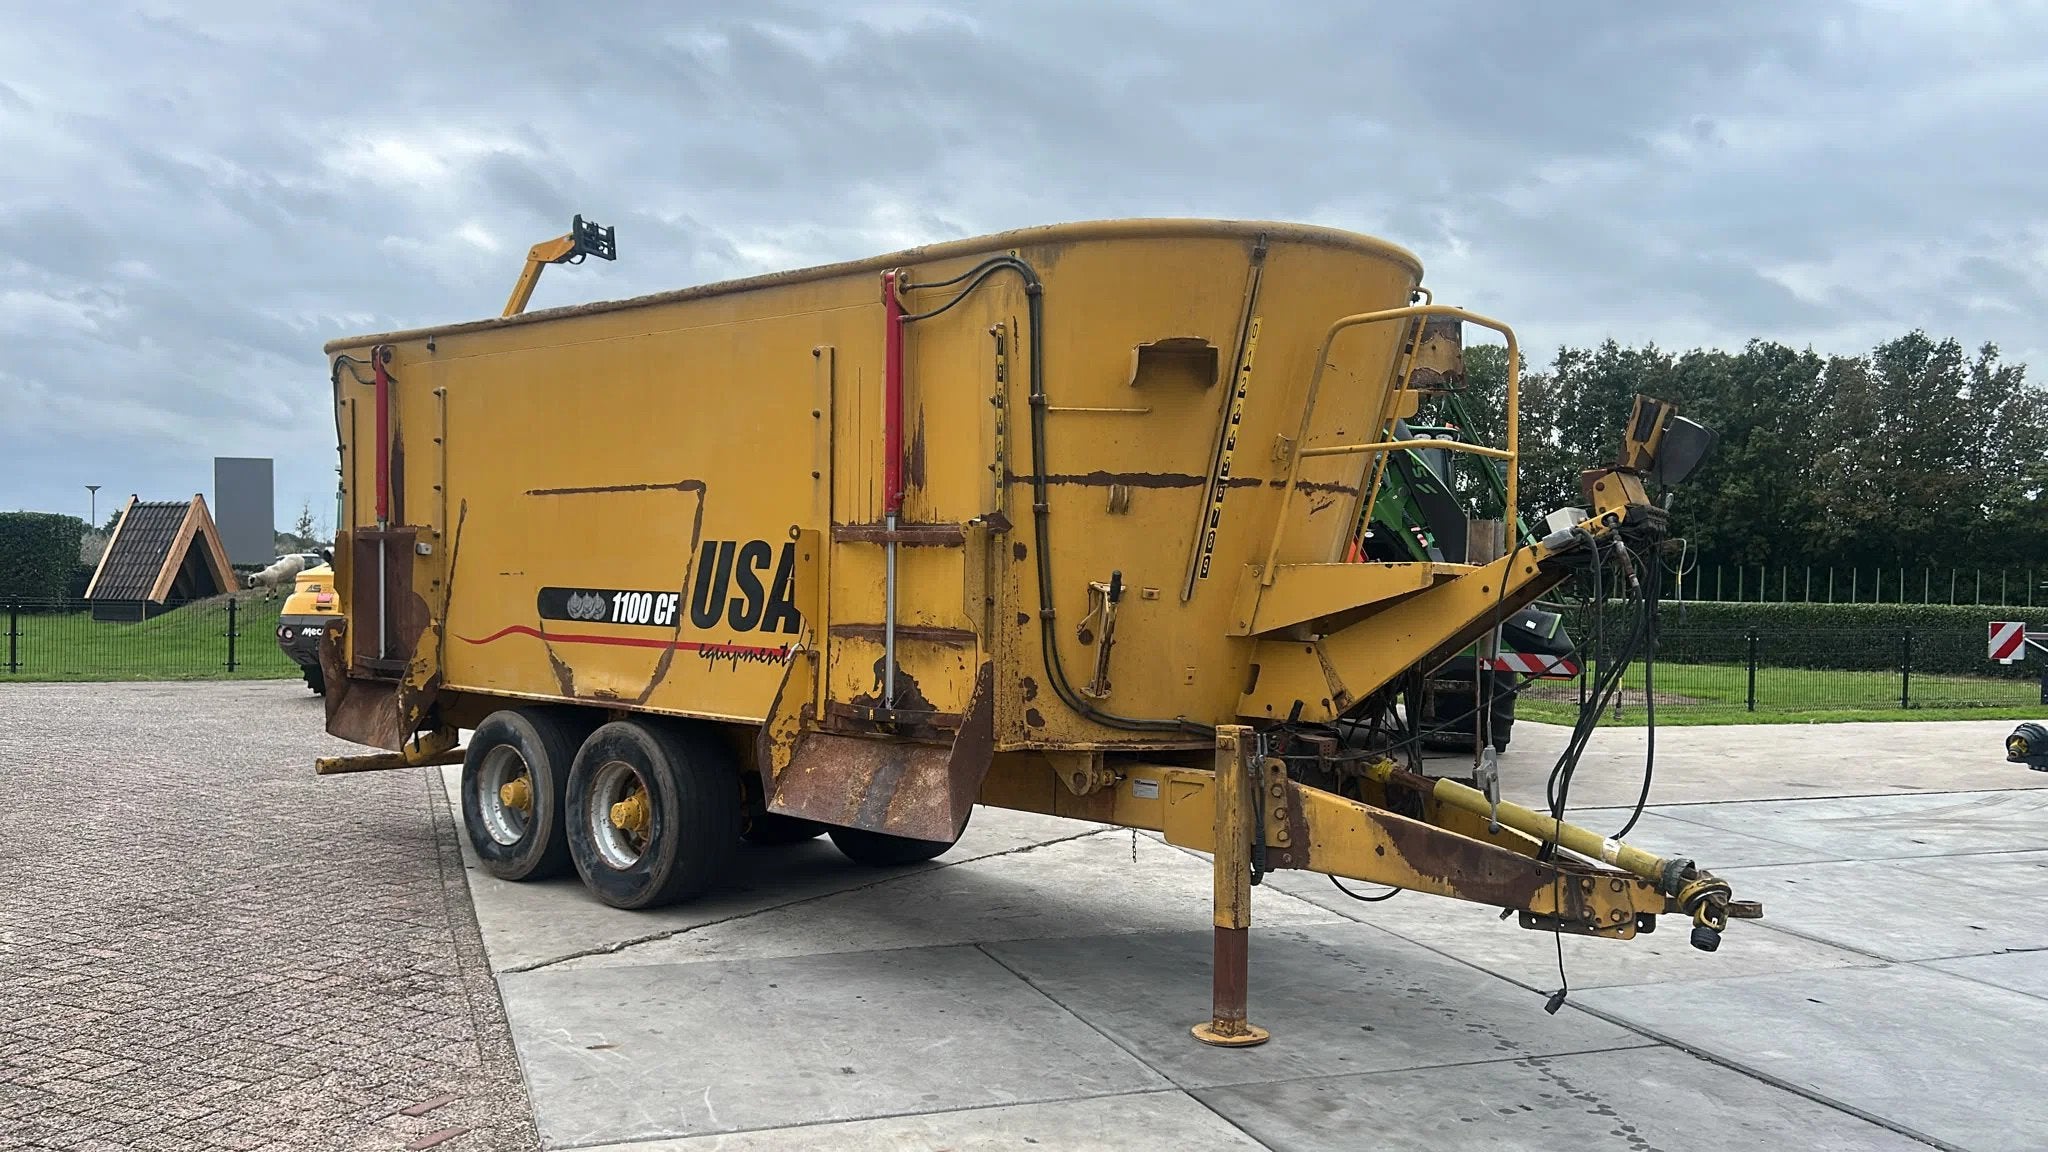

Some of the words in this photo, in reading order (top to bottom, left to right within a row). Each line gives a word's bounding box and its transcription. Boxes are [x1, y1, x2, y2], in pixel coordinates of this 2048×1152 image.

[690, 540, 800, 634] USA
[612, 592, 650, 625] 1100
[654, 593, 679, 626] CF
[698, 639, 788, 673] equipment
